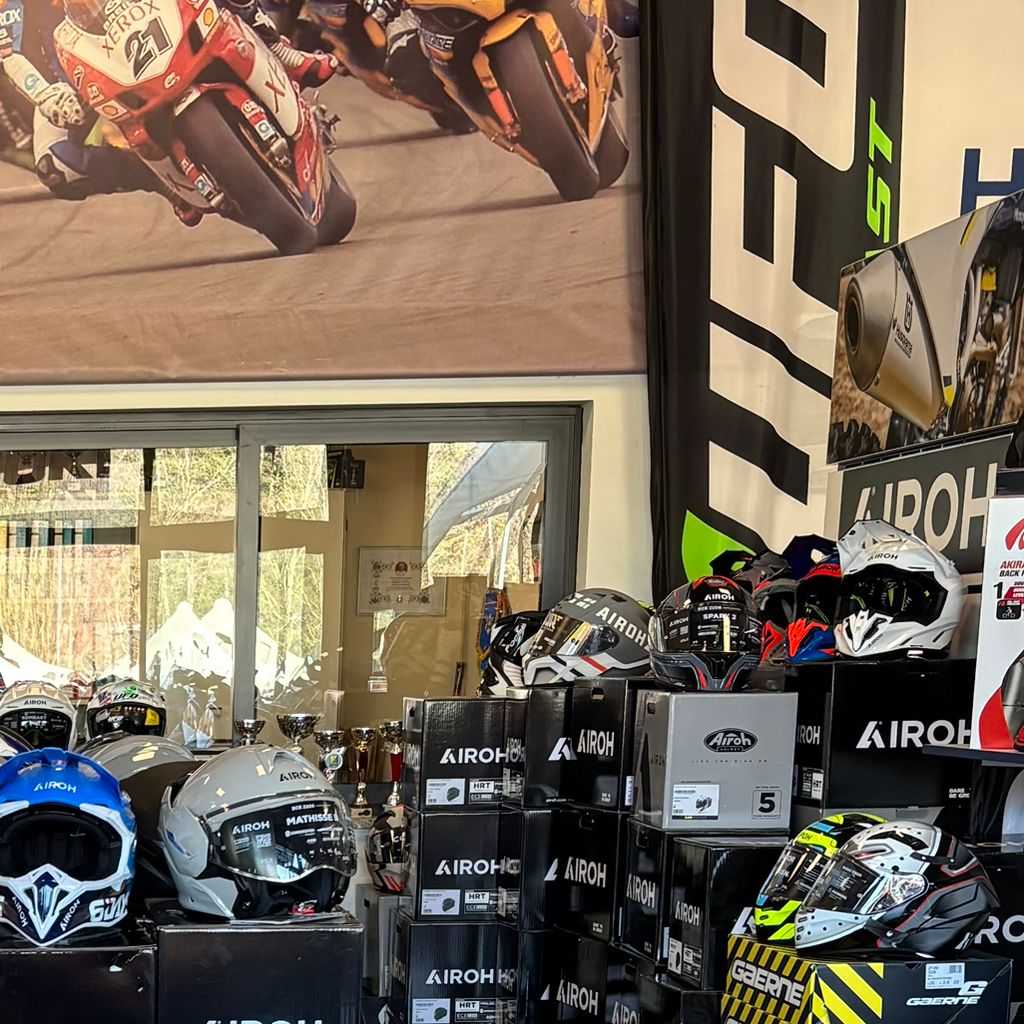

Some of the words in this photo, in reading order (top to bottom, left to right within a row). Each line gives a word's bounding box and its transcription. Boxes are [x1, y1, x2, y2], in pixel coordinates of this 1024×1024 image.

[102, 0, 160, 58] XEROX
[126, 16, 173, 81] 21
[576, 729, 615, 757] AIROH
[797, 725, 821, 745] IROH
[439, 747, 510, 764] AIROH
[33, 781, 77, 794] AIROH
[758, 792, 776, 813] 5
[232, 820, 271, 835] AIROH
[435, 859, 505, 875] AIROH
[564, 857, 607, 888] AIROH
[626, 873, 656, 909] AIROH
[675, 900, 701, 928] AIROH
[425, 968, 495, 985] AIROH
[556, 979, 599, 1016] AIROH
